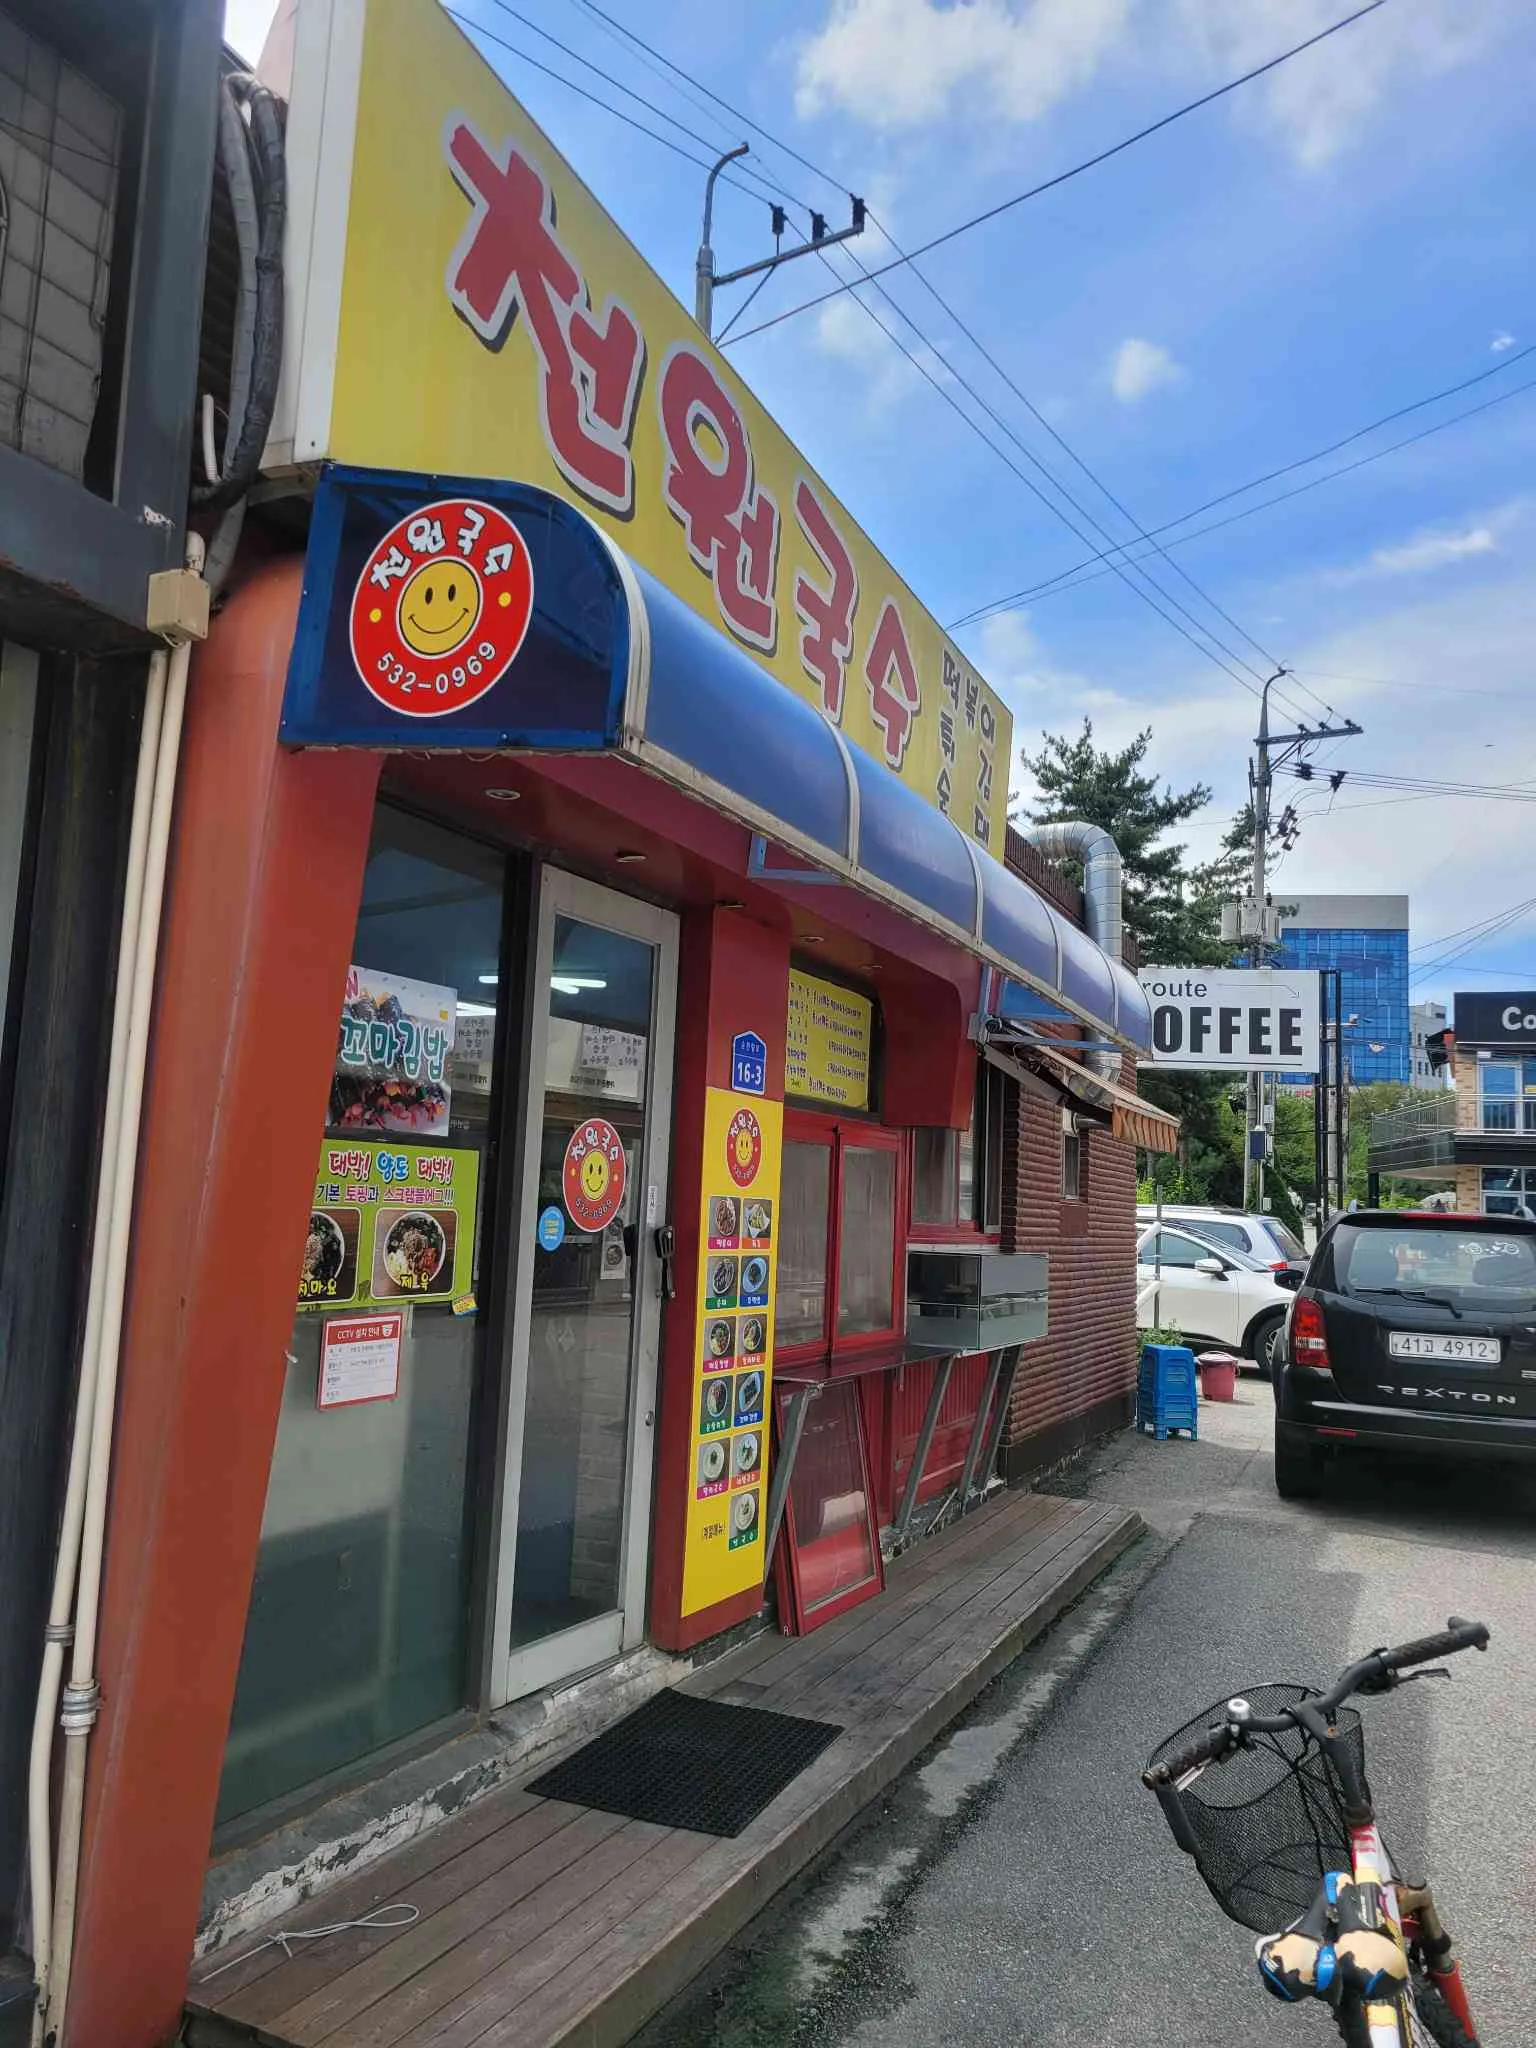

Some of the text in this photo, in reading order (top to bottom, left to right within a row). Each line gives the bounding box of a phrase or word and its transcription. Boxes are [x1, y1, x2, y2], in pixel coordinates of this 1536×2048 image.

[446, 118, 921, 770] 천원국수
[370, 507, 514, 590] 천원국수
[377, 641, 496, 693] 532-0969
[1142, 979, 1208, 998] route
[1153, 1005, 1303, 1056] OFFEE
[737, 1061, 762, 1087] 16-3
[571, 1126, 619, 1161] 천원국수
[328, 1151, 372, 1181] 대박!
[416, 1156, 454, 1184] 대박!
[316, 1184, 340, 1202] 기본
[344, 1184, 379, 1203] 토핑과
[1443, 1340, 1487, 1358] 4912
[1377, 1385, 1517, 1405] REXTON
